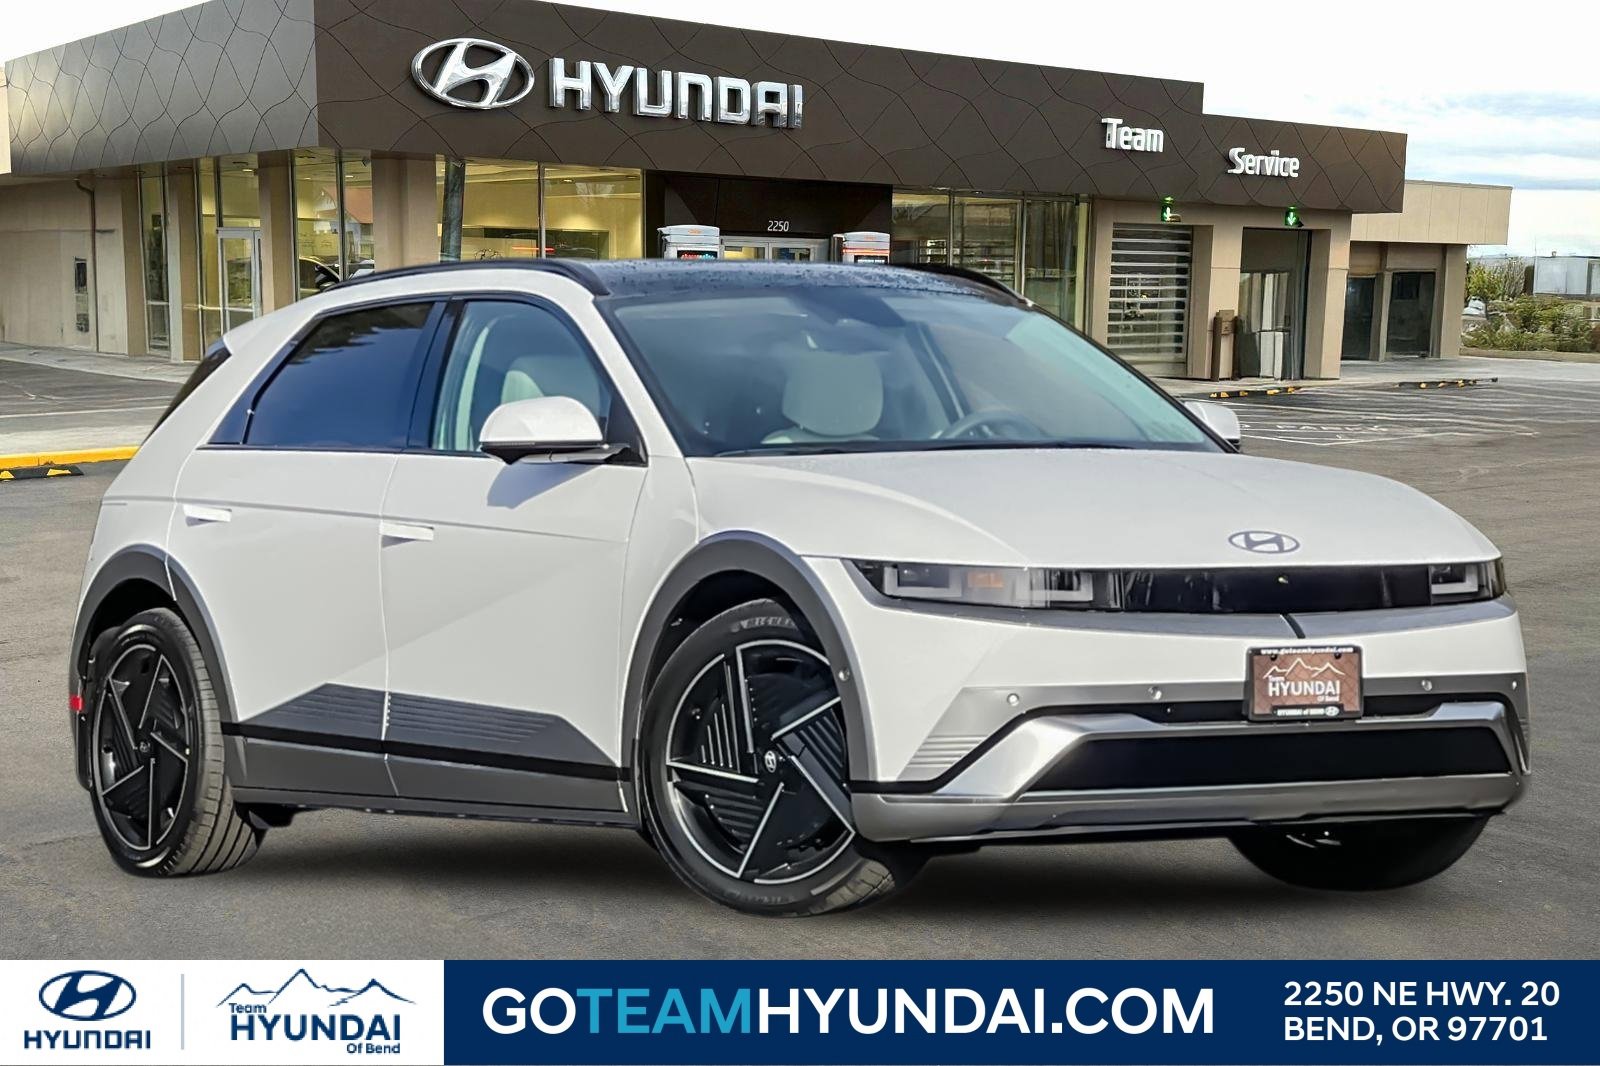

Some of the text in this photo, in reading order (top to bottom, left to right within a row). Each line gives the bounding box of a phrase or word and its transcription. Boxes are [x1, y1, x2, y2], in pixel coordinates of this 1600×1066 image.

[549, 57, 804, 130] HYUNDAI
[1101, 117, 1164, 153] Team
[1227, 147, 1300, 178] Service
[767, 220, 790, 232] 2250
[1268, 680, 1340, 697] HYUNDAI
